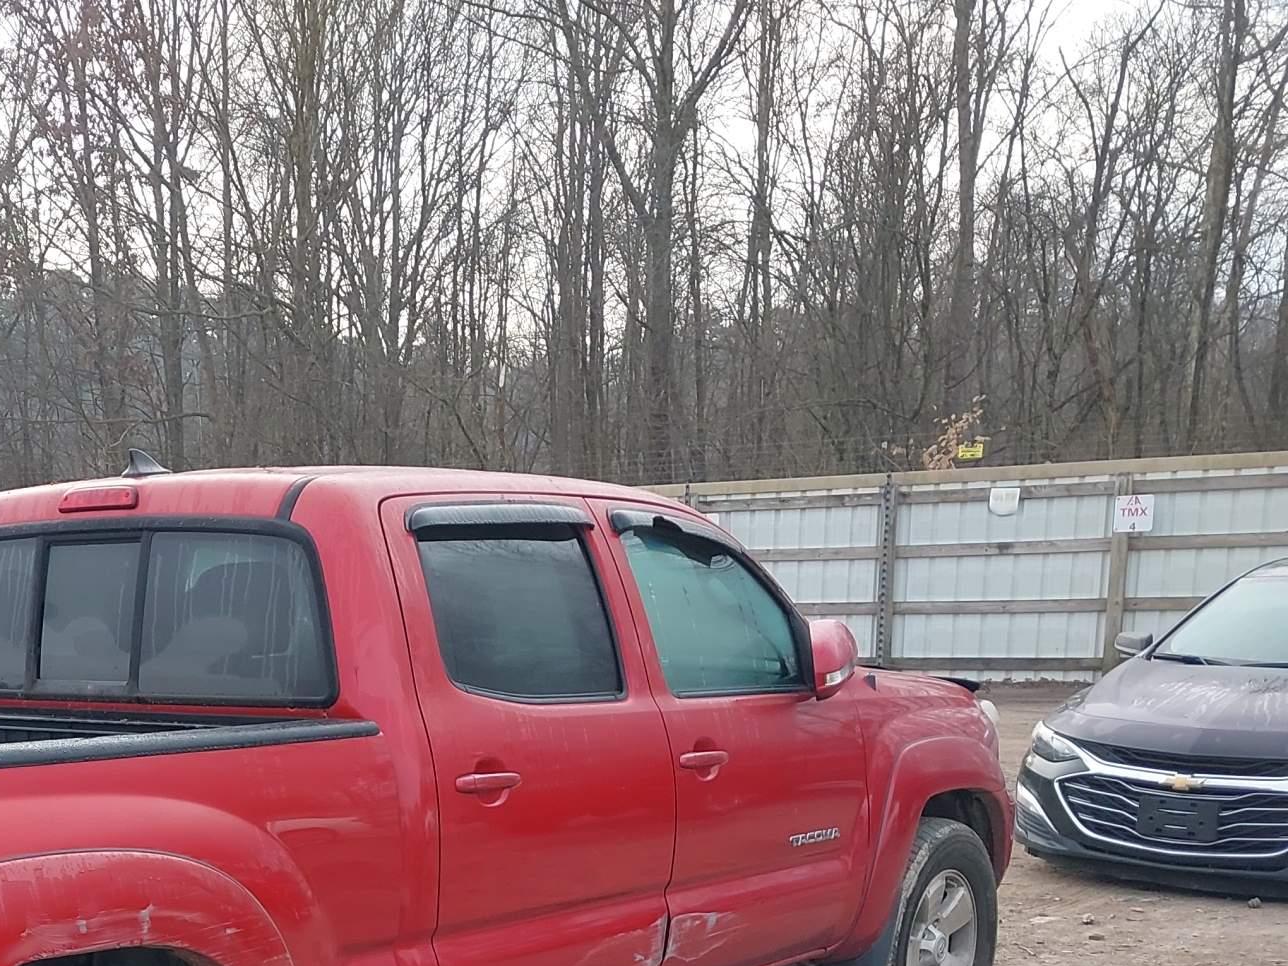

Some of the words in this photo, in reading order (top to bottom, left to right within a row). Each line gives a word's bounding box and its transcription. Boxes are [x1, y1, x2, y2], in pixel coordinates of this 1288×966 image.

[1120, 507, 1148, 517] TMX
[1129, 522, 1136, 530] 4
[789, 827, 840, 847] TACOMA
